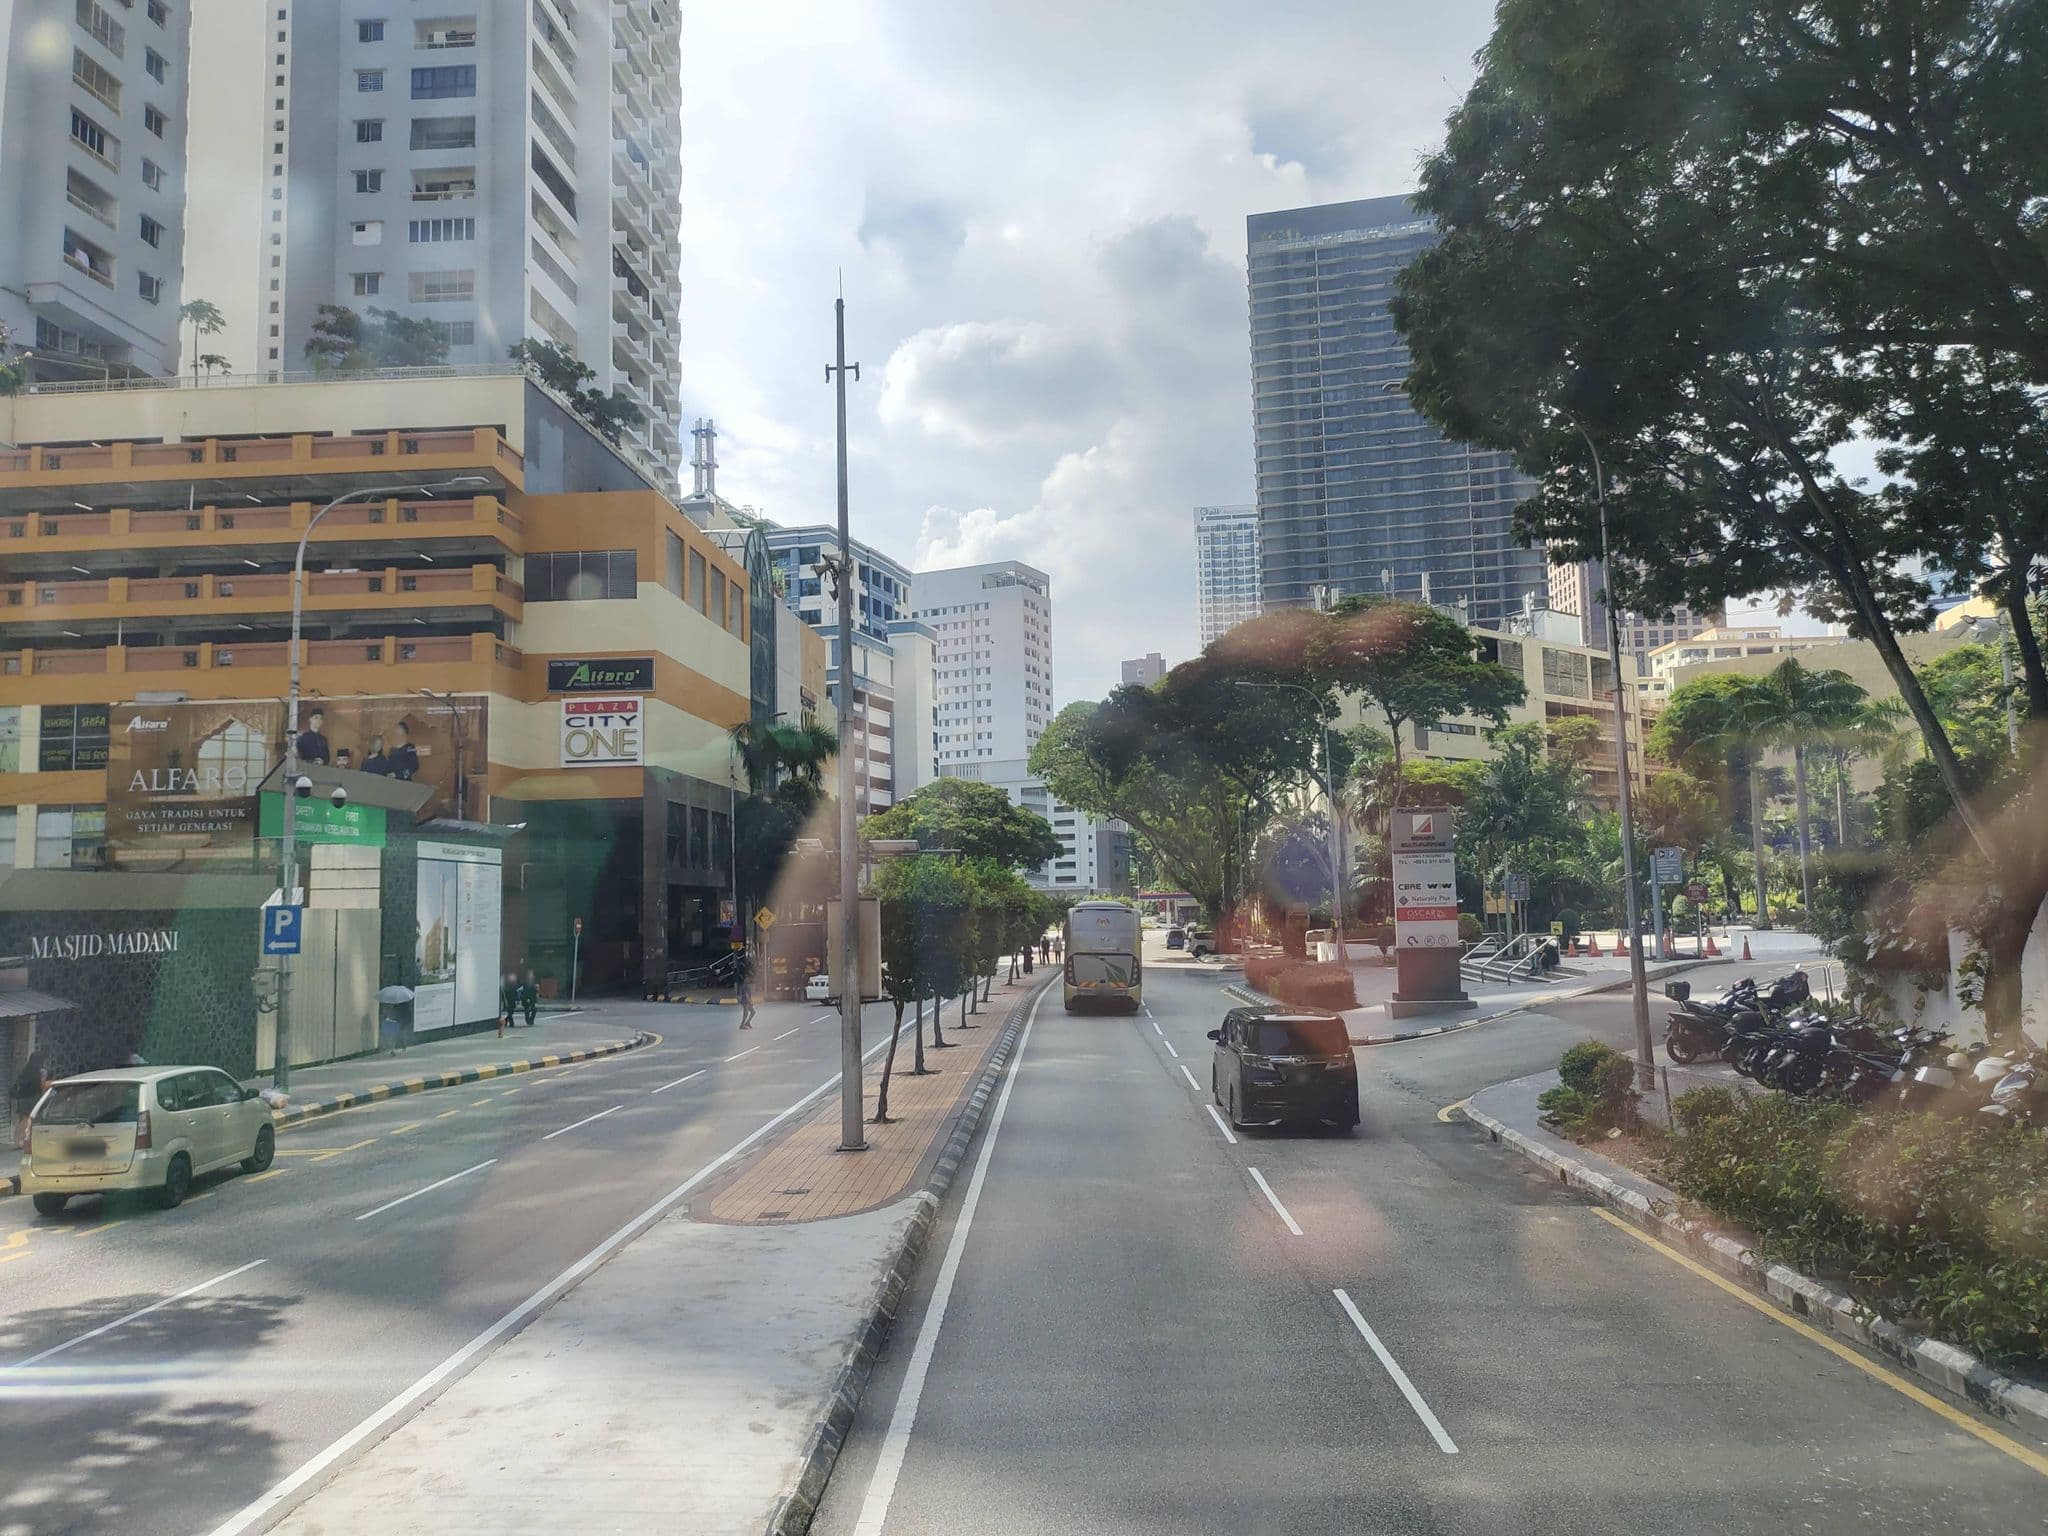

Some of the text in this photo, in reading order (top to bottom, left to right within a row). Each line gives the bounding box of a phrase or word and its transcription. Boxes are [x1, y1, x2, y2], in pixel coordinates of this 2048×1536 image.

[566, 664, 636, 687] Alfaro
[568, 702, 634, 712] PLAZA
[125, 715, 168, 733] Alfaro
[565, 715, 637, 728] CITY
[565, 728, 638, 758] ONE
[128, 766, 247, 792] ALFARO
[126, 808, 246, 820] GAYA TRADISI UNTUK
[138, 822, 233, 832] SETIAP GENERASI
[275, 910, 293, 935] P
[29, 931, 179, 961] MASJID MADANI
